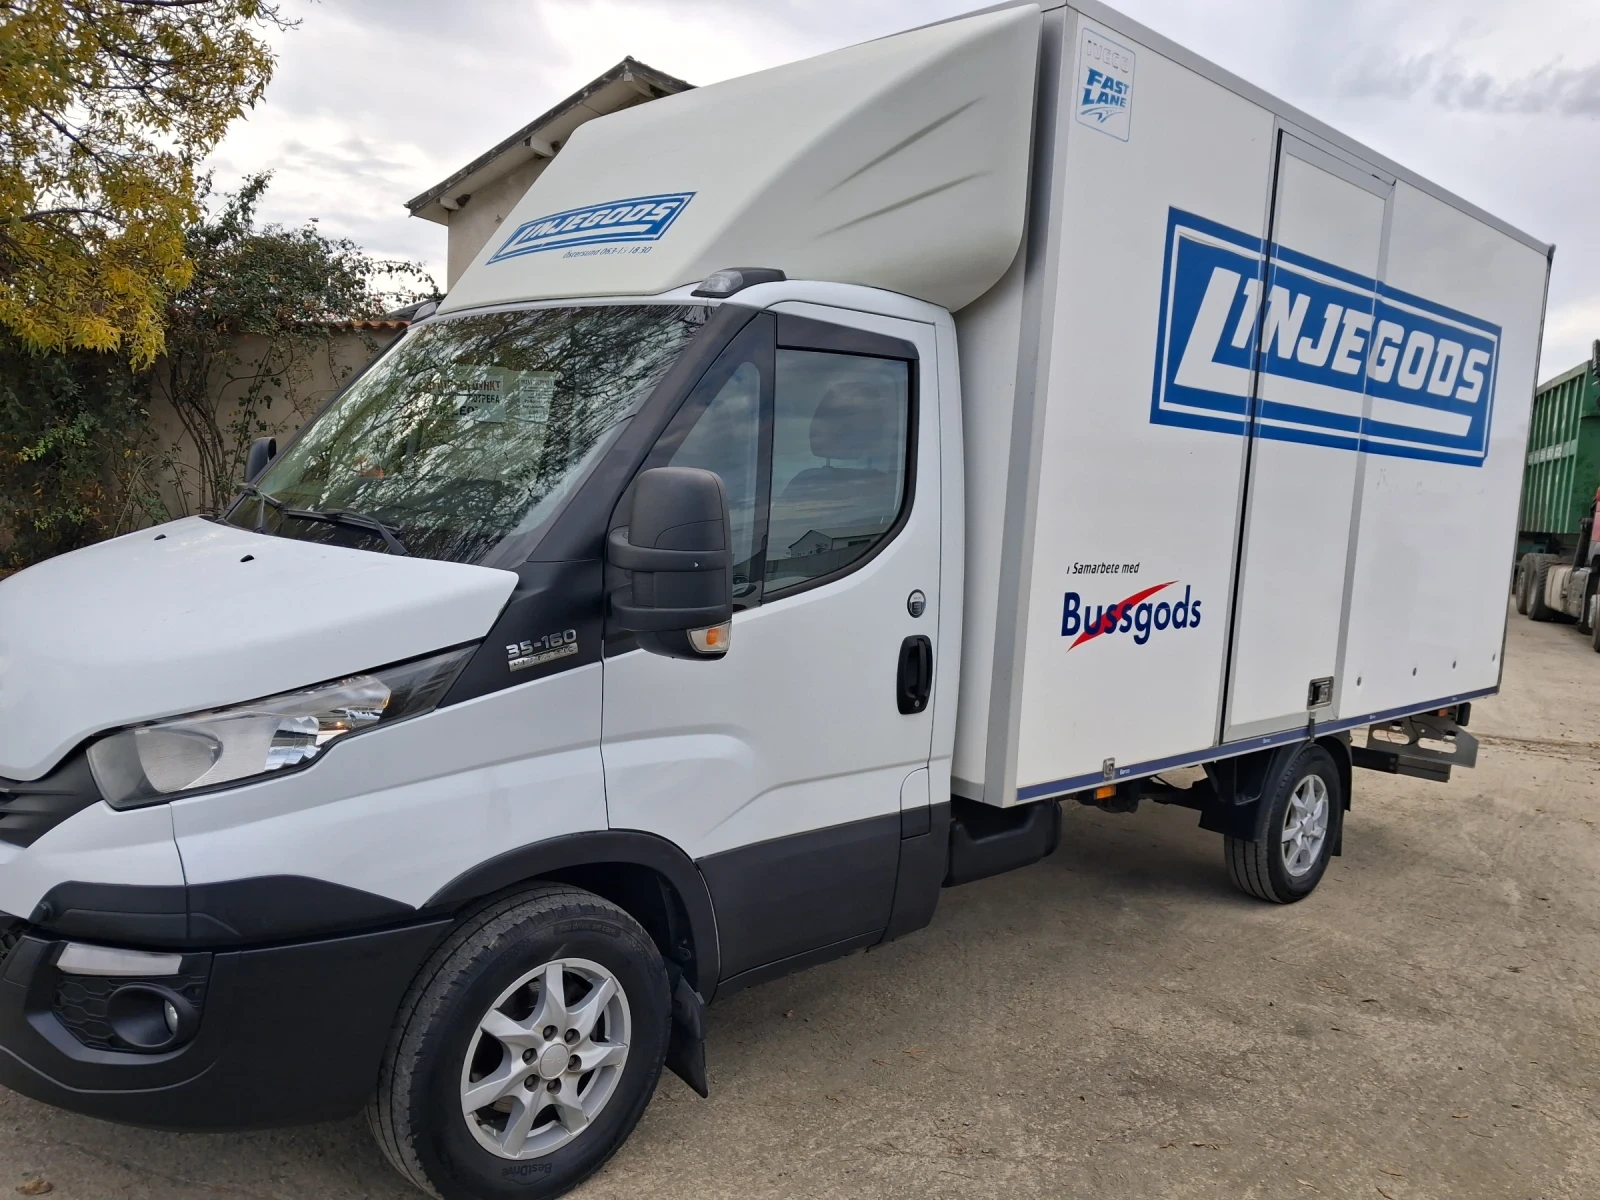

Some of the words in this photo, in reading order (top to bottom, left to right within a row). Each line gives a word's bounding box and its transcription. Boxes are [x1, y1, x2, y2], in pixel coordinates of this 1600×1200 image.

[1086, 66, 1130, 95] FAST
[1081, 87, 1127, 108] LANE
[495, 201, 680, 257] LINJEGODS
[1173, 266, 1491, 436] LINJEGODS
[1072, 562, 1120, 575] Samarbete
[1121, 562, 1140, 574] med
[1061, 584, 1202, 645] Bussgods
[505, 628, 577, 659] 35-160
[501, 1162, 553, 1178] BestDrive
